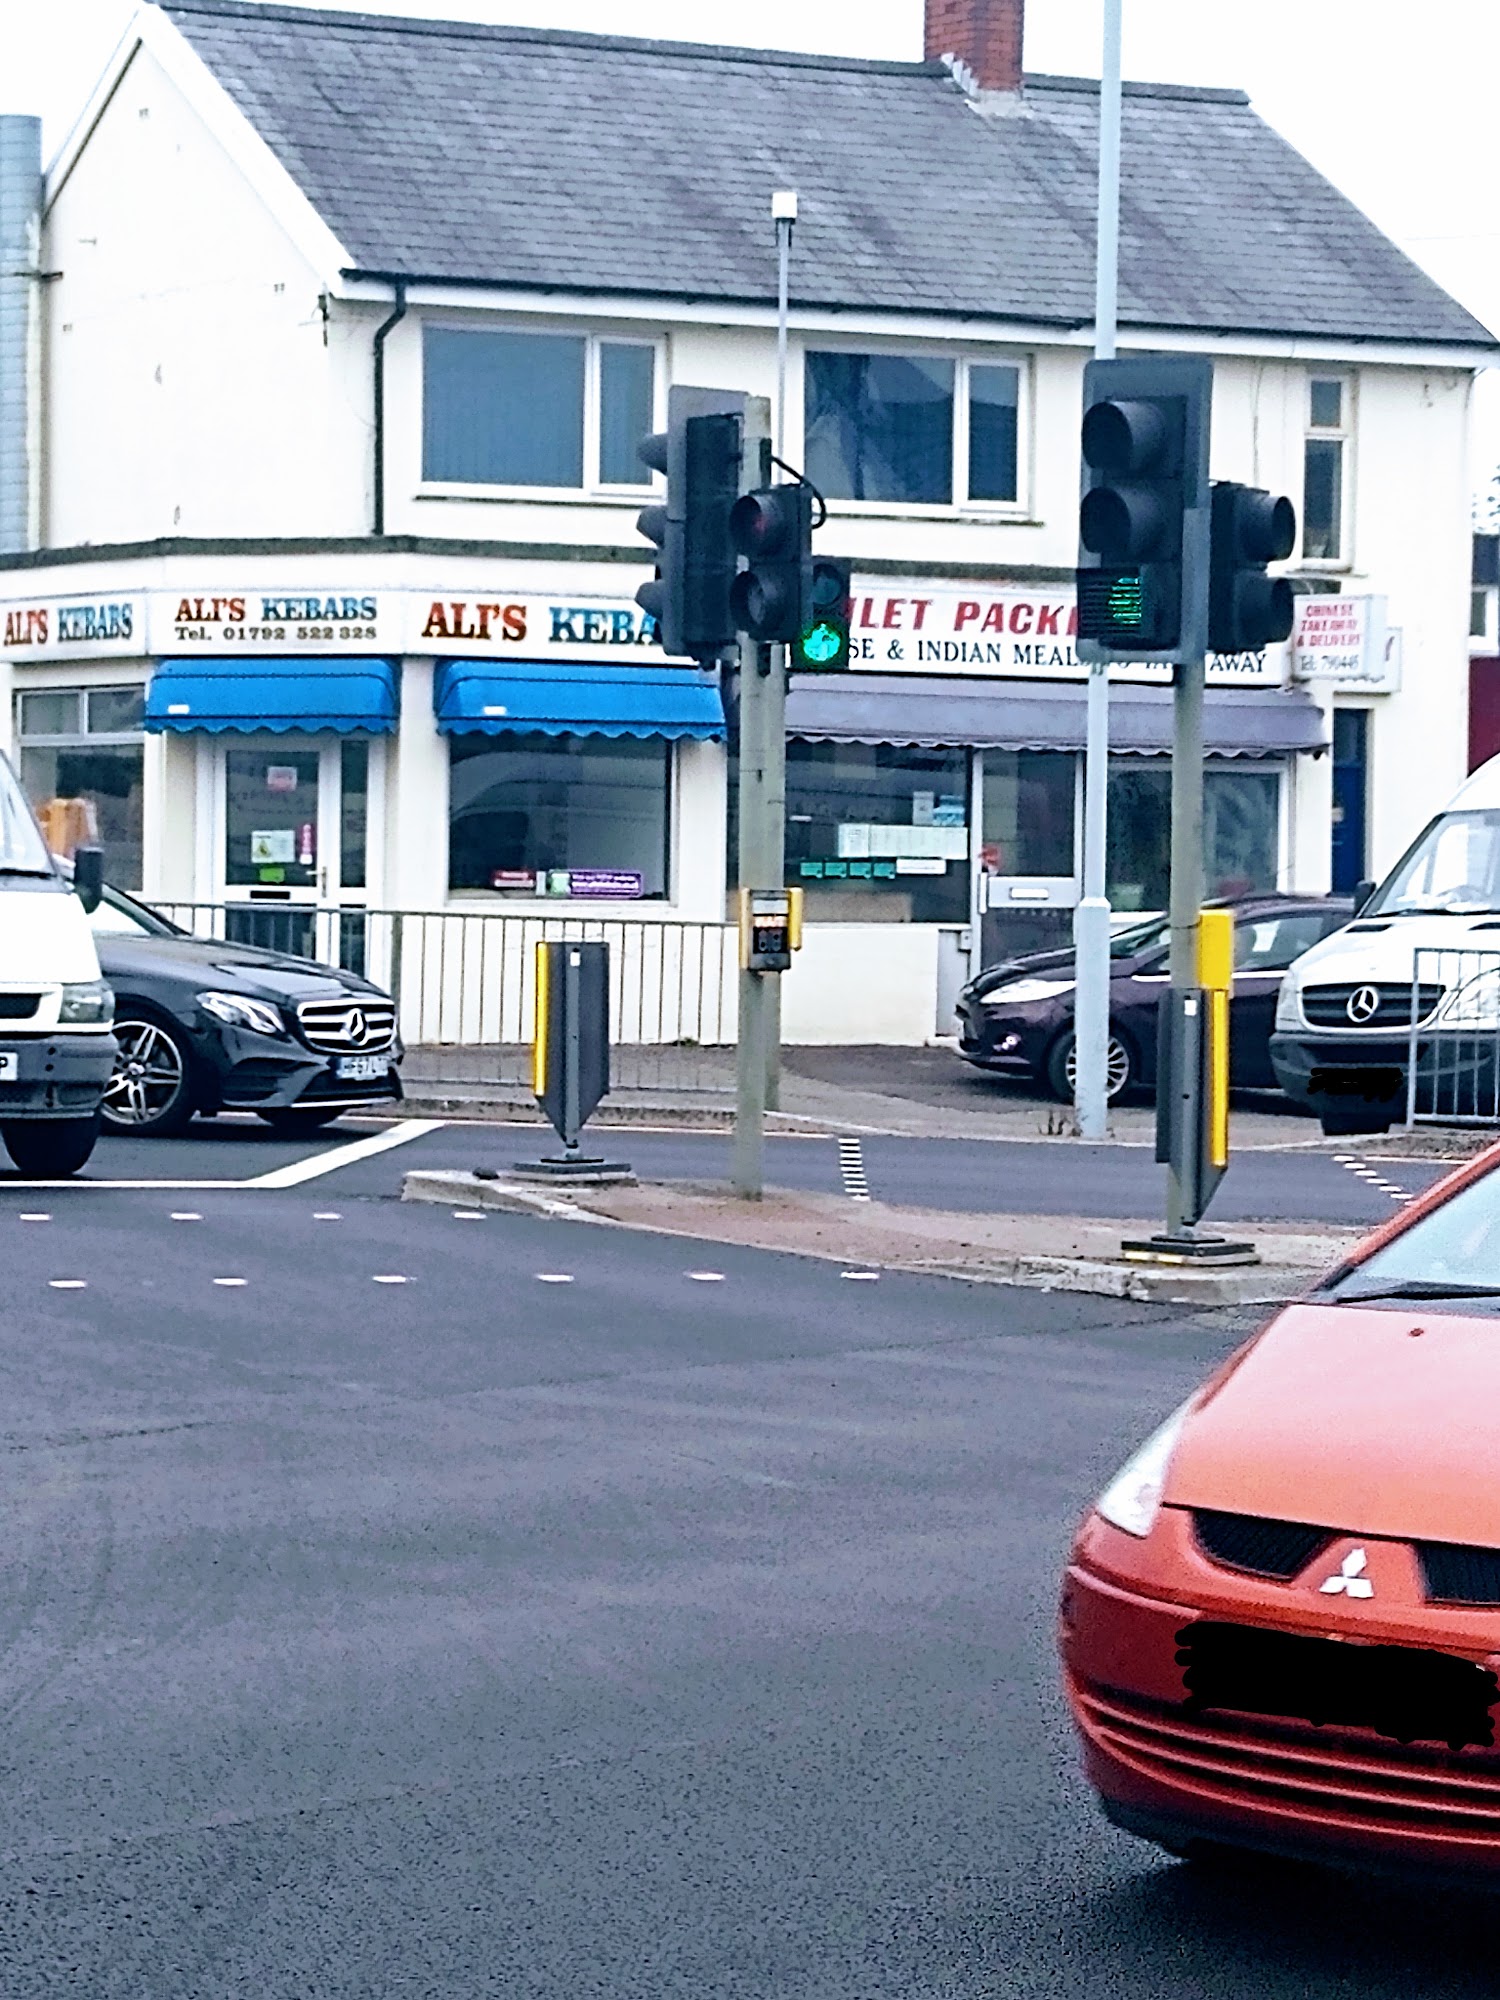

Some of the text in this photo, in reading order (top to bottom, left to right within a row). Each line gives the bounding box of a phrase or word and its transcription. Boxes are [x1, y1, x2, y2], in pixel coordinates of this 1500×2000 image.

[174, 597, 378, 622] ALI'S KEBABS
[421, 601, 528, 642] ALI'S
[1306, 603, 1354, 618] CHINESE
[4, 603, 133, 647] ALI'S KEBABS
[175, 626, 212, 641] Tel.
[223, 626, 286, 641] 01792
[1309, 633, 1360, 647] DELIVERY
[887, 638, 905, 660] &
[918, 640, 1002, 664] INDIAN
[1012, 643, 1086, 667] MEAL
[1210, 652, 1267, 673] AWAY
